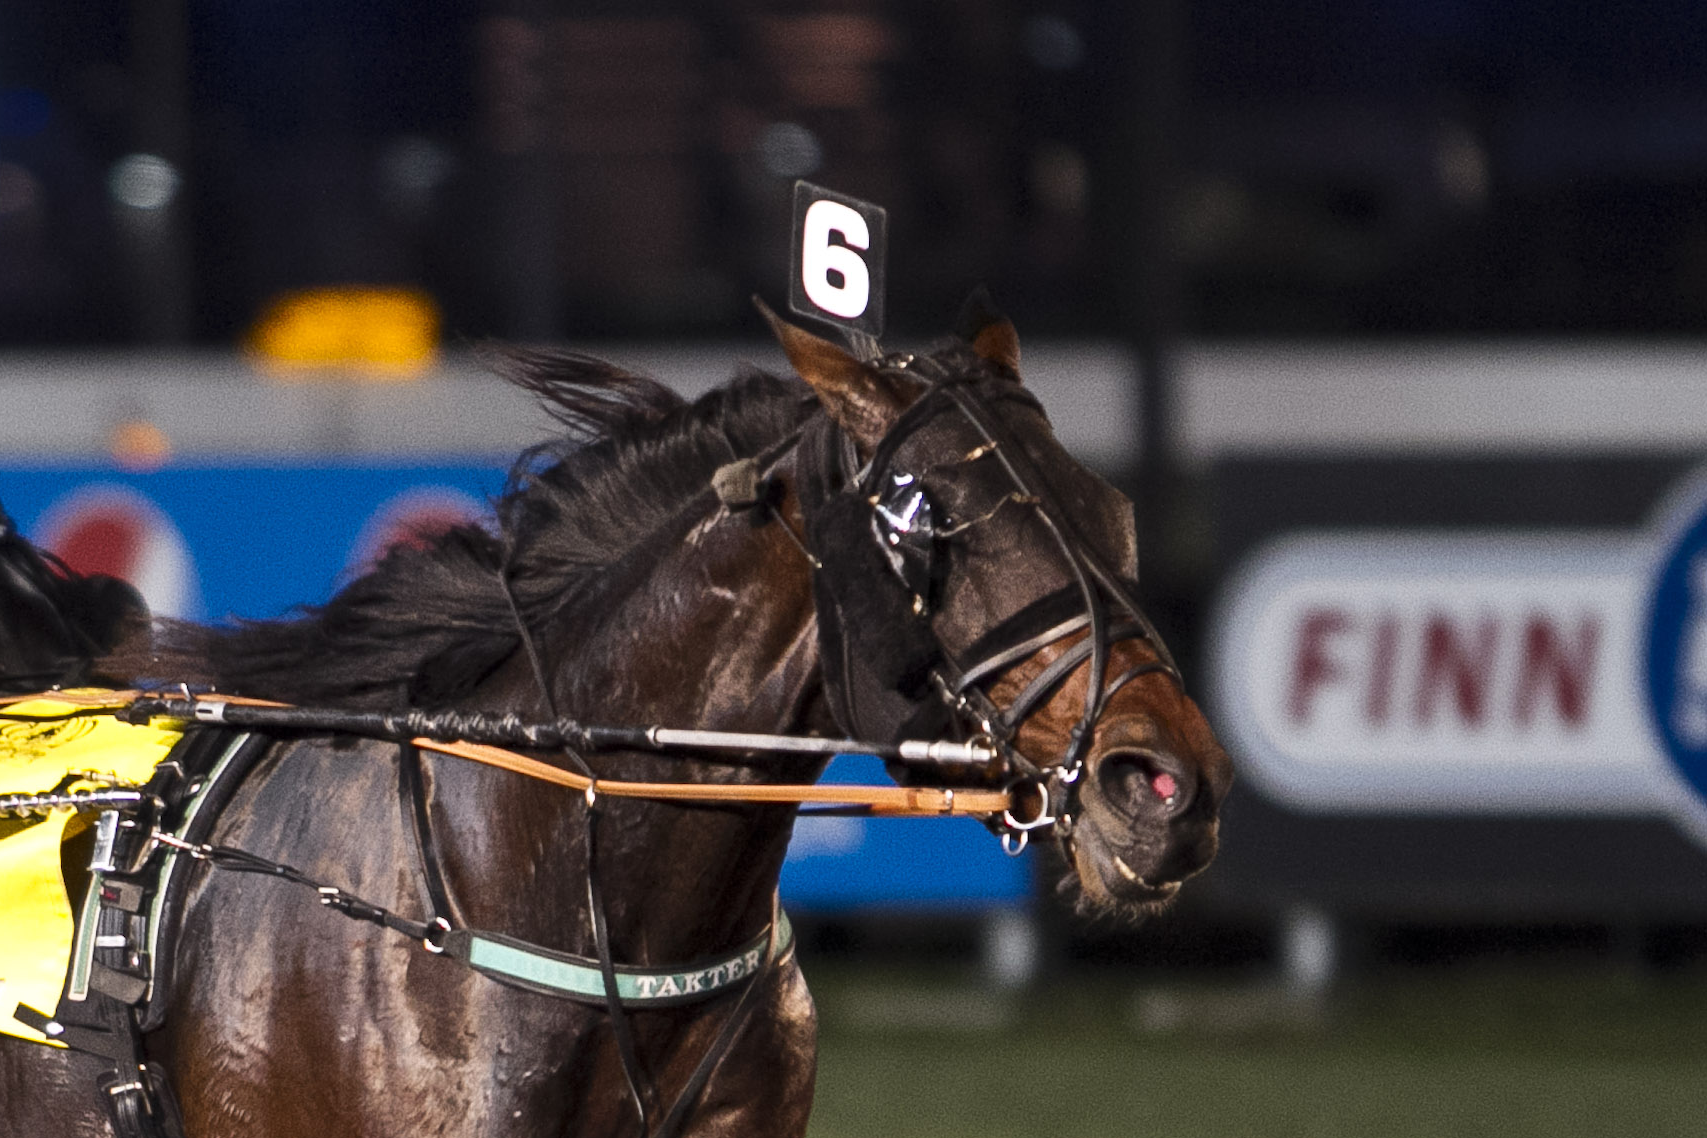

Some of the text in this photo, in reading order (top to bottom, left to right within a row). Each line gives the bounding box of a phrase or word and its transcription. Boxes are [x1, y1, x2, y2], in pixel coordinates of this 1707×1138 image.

[802, 199, 870, 319] 6
[1285, 604, 1604, 732] FINN
[637, 949, 760, 999] TAKTER
